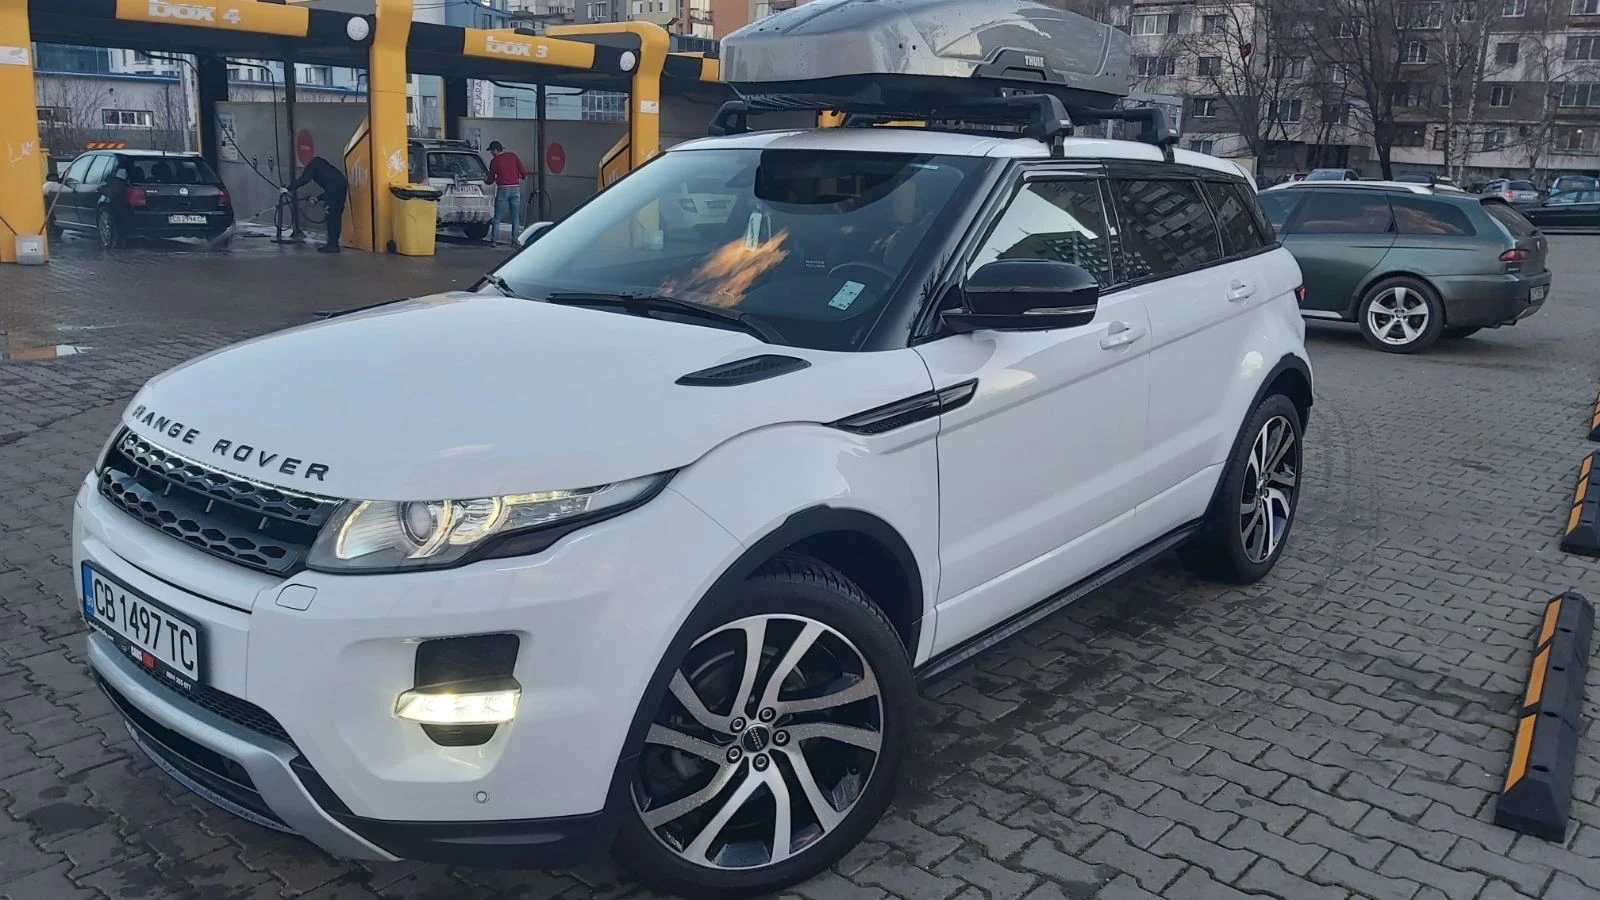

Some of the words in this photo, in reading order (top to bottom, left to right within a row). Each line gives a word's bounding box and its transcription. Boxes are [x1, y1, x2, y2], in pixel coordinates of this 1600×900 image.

[148, 0, 215, 21] box
[222, 9, 241, 24] 4
[486, 35, 532, 57] box
[535, 45, 549, 58] 3
[1024, 55, 1045, 68] THULE
[132, 404, 200, 445] RANGE
[212, 438, 330, 482] ROVER
[94, 578, 116, 623] CB
[120, 594, 161, 650] 1497
[166, 619, 194, 671] TC
